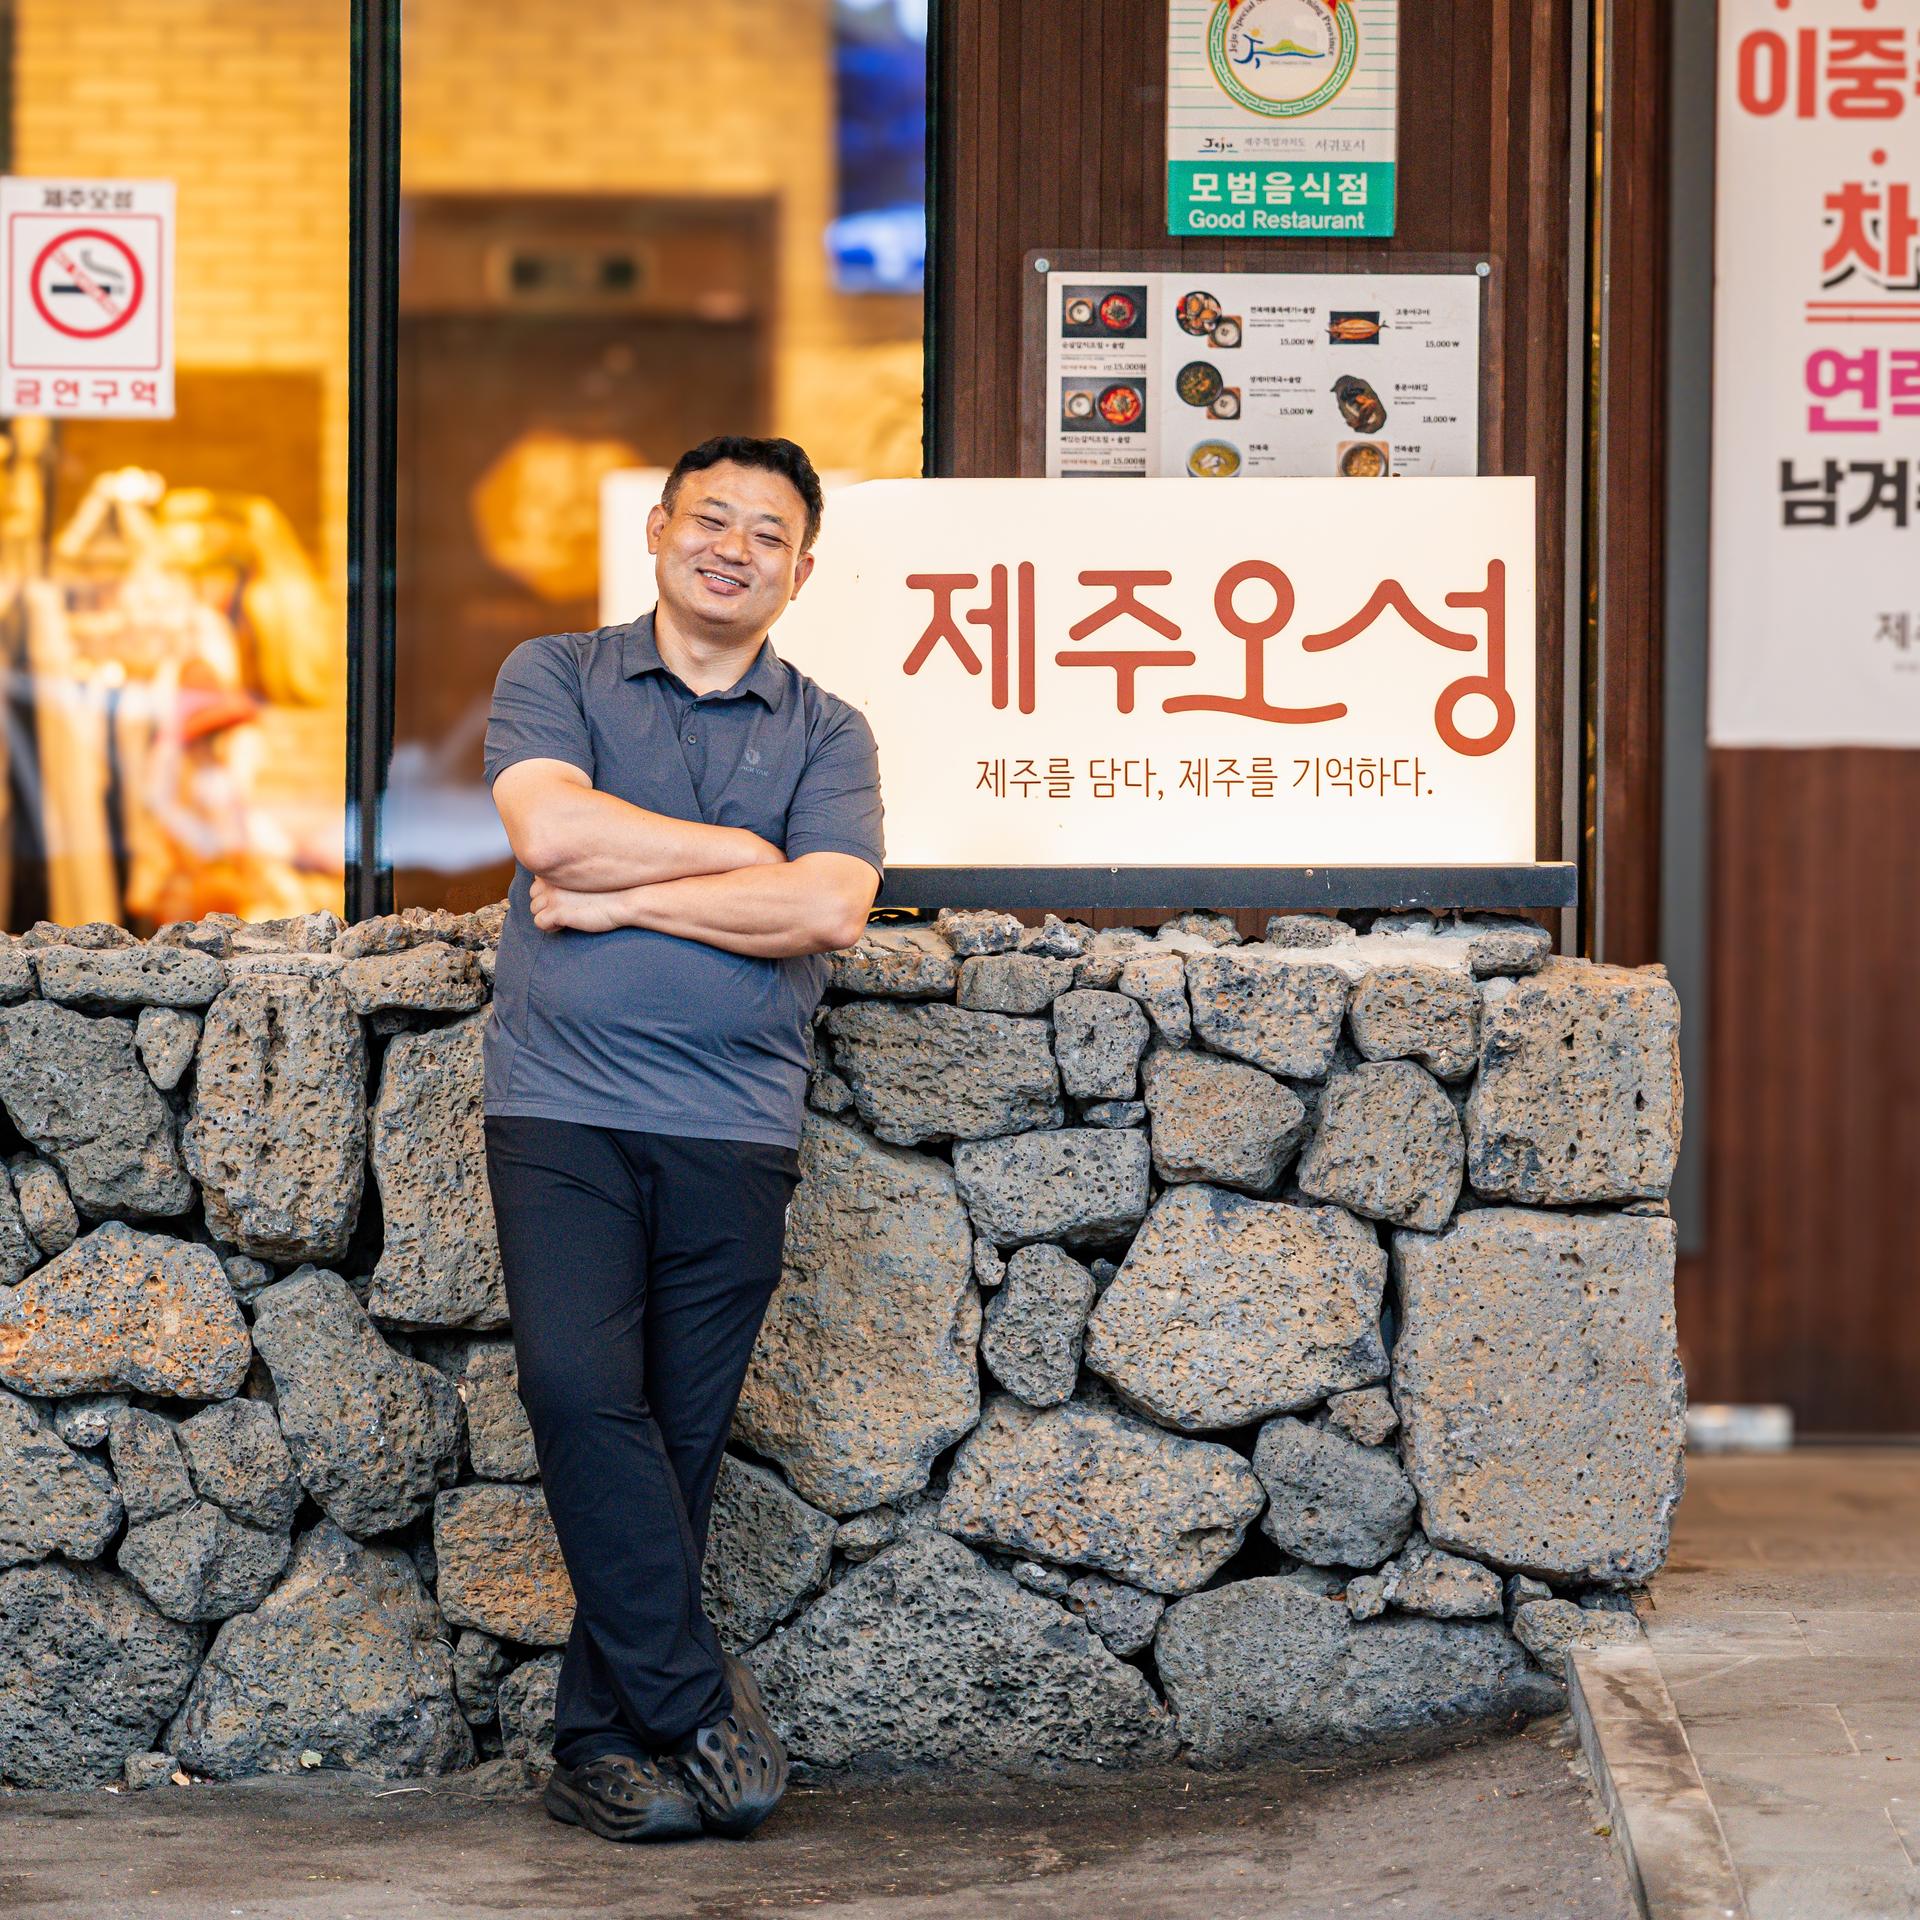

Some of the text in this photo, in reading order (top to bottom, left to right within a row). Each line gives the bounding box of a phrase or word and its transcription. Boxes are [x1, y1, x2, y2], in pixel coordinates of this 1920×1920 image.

[1738, 27, 1920, 119] 이중
[1203, 137, 1234, 152] Jeju
[1314, 138, 1366, 152] 서귀포시
[42, 188, 133, 209] 제주오성
[1189, 171, 1369, 206] 모범음식점
[1189, 208, 1365, 230] Good Restaurant
[1425, 340, 1451, 348] 15,000
[15, 378, 157, 408] 금연구역
[1280, 407, 1304, 415] 15,000
[1780, 460, 1920, 527] 남겨
[1875, 611, 1920, 650] 제
[903, 559, 1516, 756] 제주오성
[976, 757, 1434, 800] 제주를 담다, 제주를 기억하다.
